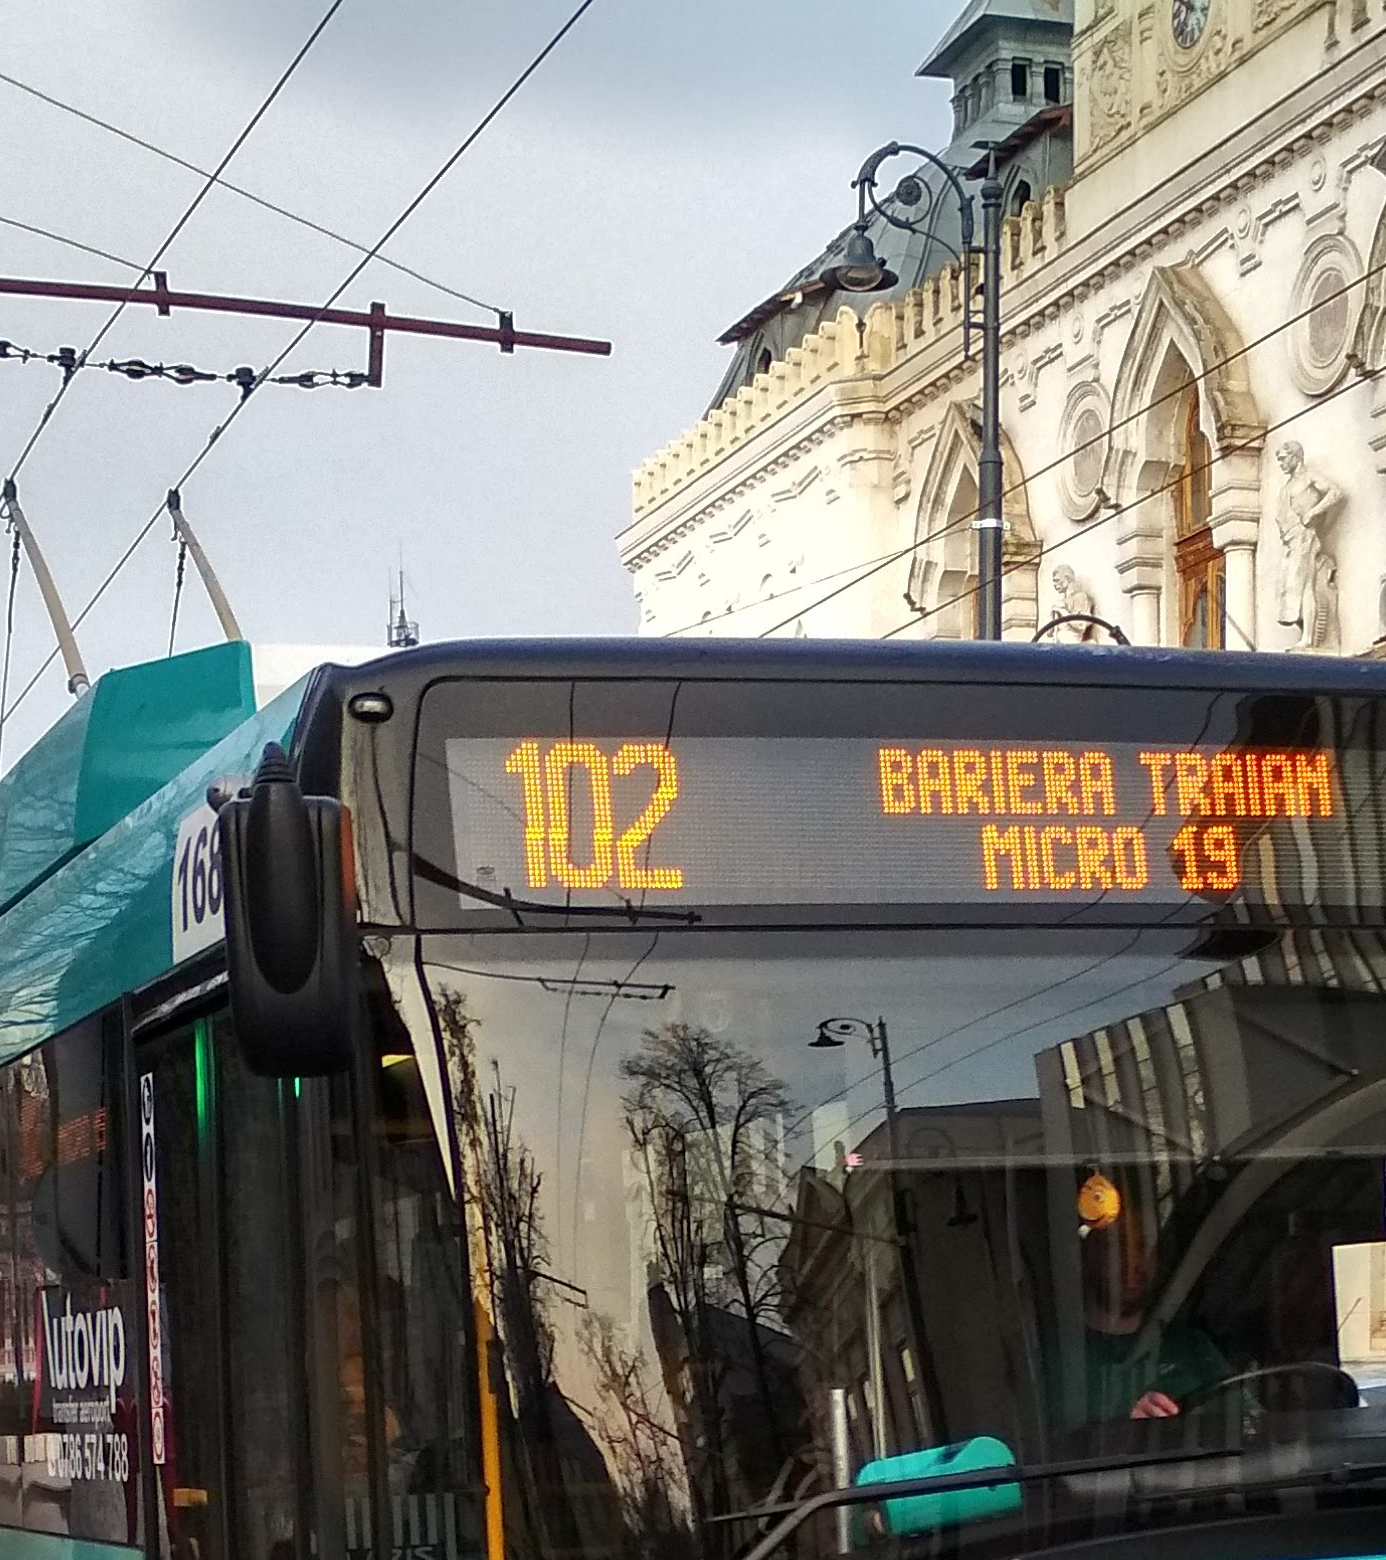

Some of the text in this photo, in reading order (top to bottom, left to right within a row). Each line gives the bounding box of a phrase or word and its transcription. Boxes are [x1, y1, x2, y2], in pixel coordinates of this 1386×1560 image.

[505, 741, 683, 888] 102
[877, 748, 1334, 817] BARIERA TRAIAN
[980, 823, 1240, 891] MICRO 19
[84, 1432, 105, 1481] 574
[106, 1432, 129, 1483] 788
